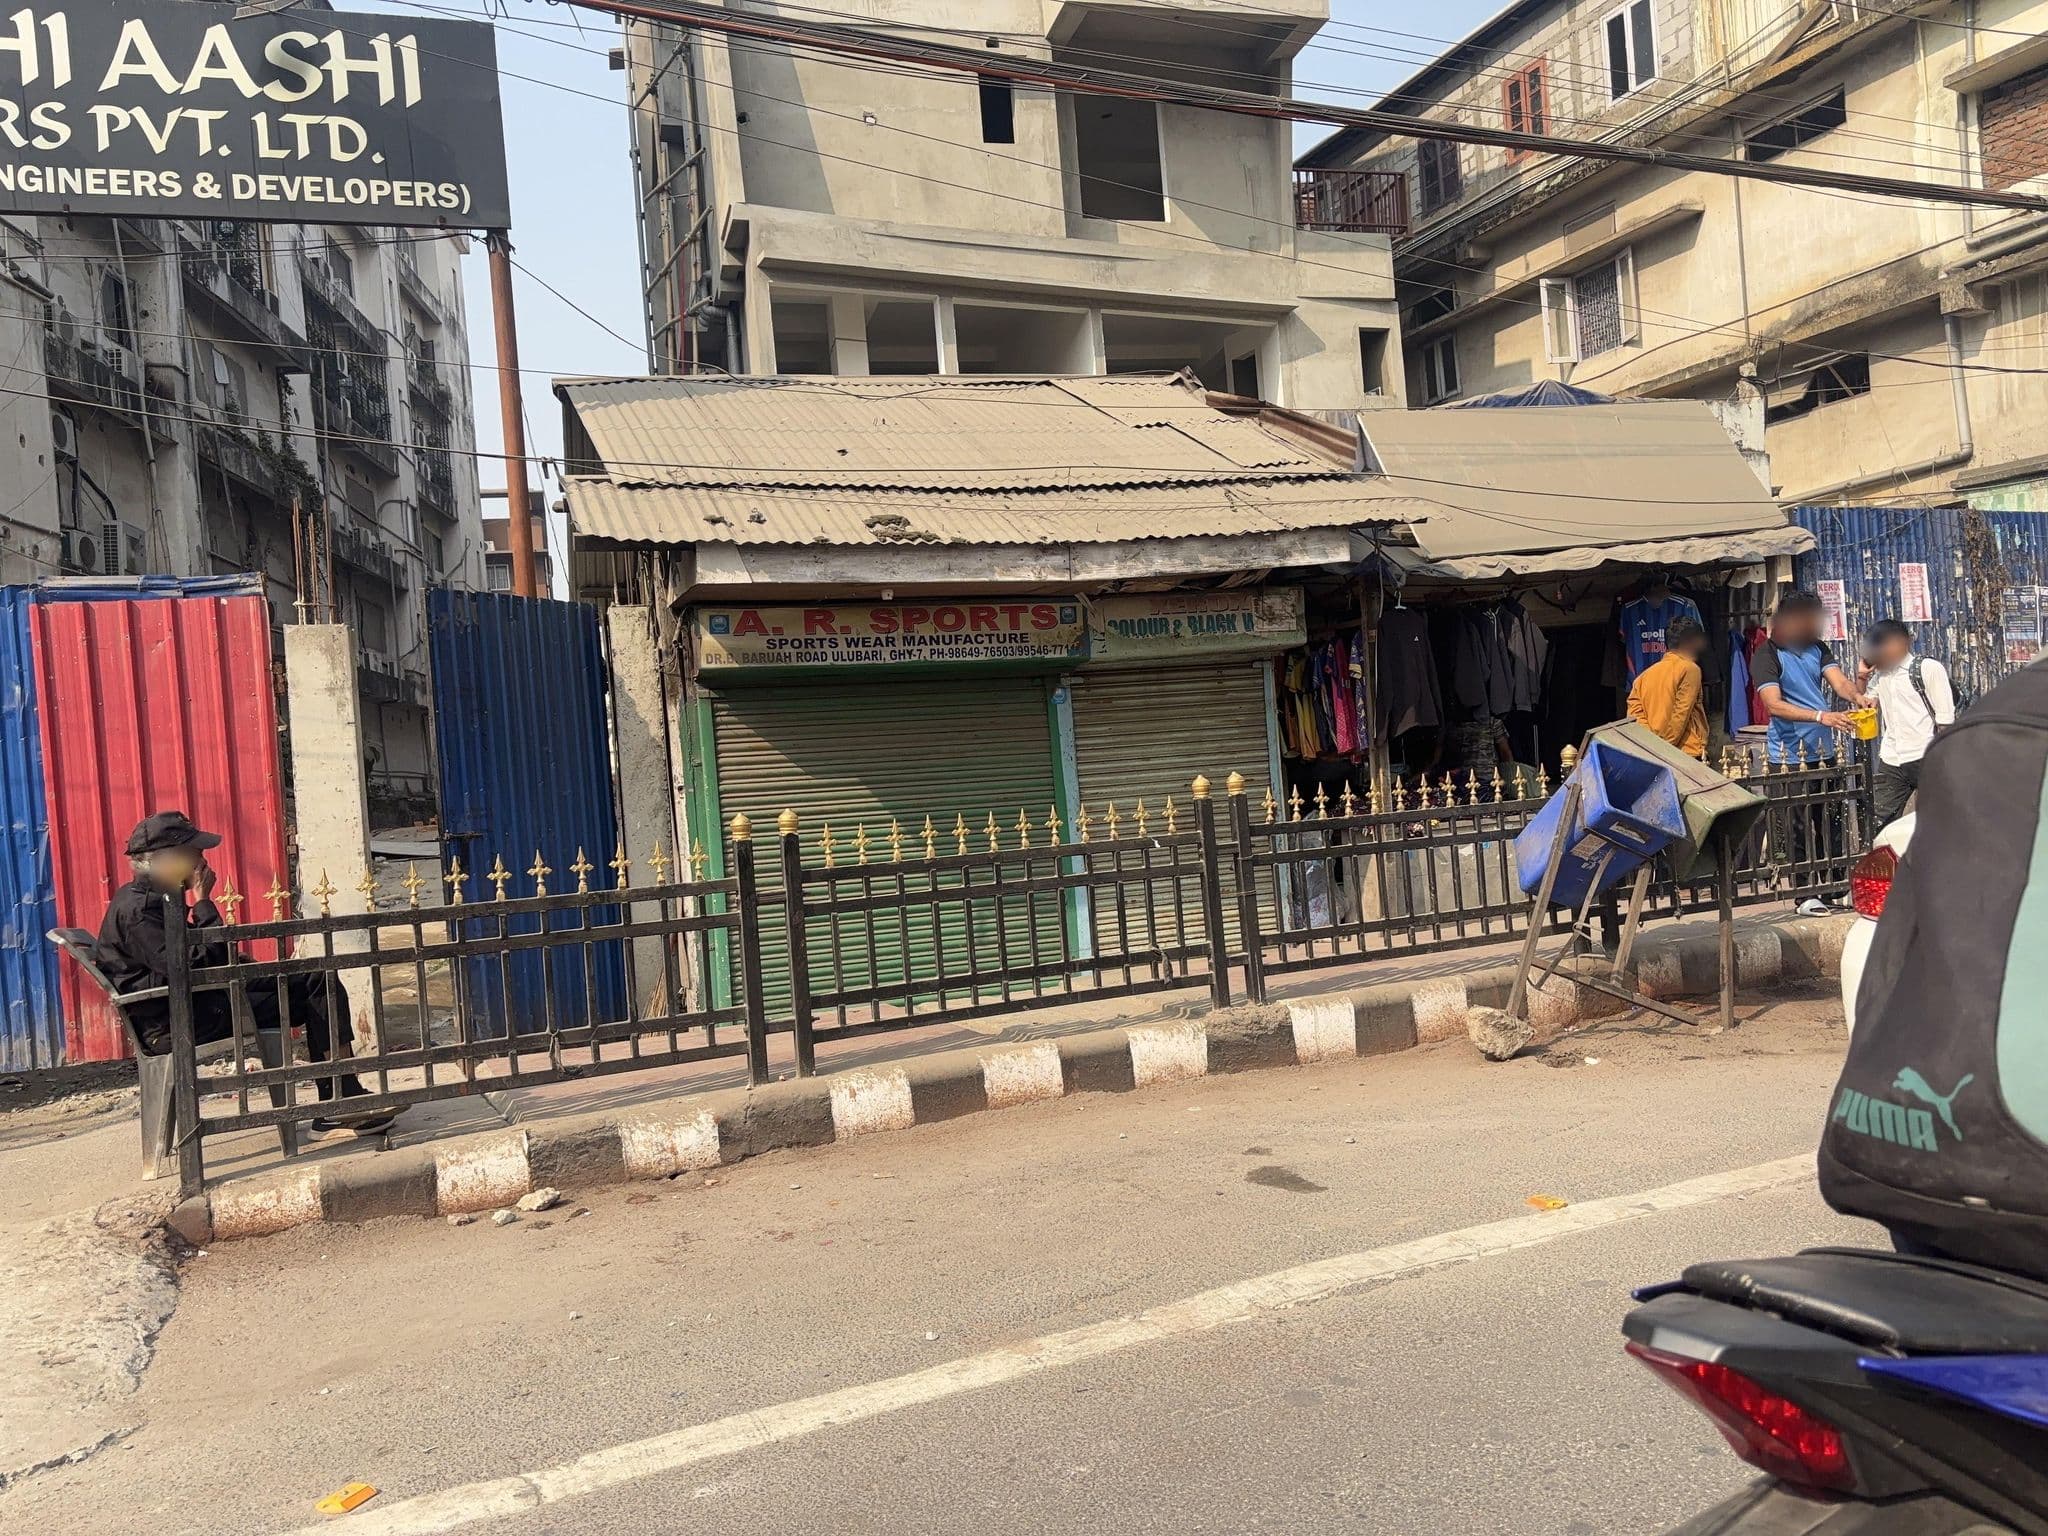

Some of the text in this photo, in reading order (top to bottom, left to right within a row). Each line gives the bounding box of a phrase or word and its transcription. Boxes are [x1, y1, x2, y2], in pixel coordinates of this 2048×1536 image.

[99, 18, 422, 108] AASHI
[0, 99, 385, 164] RS PVT. LTD.
[0, 164, 471, 214] NGINEERS & DEVELOPERS)
[733, 610, 784, 636] A.
[804, 609, 851, 635] R.
[869, 604, 1059, 634] SPORTS
[766, 632, 1030, 650] SPORTS WEAR MANUFACTURE
[743, 651, 792, 664] BARUAH
[796, 650, 828, 663] ROAD
[835, 649, 886, 663] ULUBARI,
[1832, 1087, 1938, 1152] PUMA
